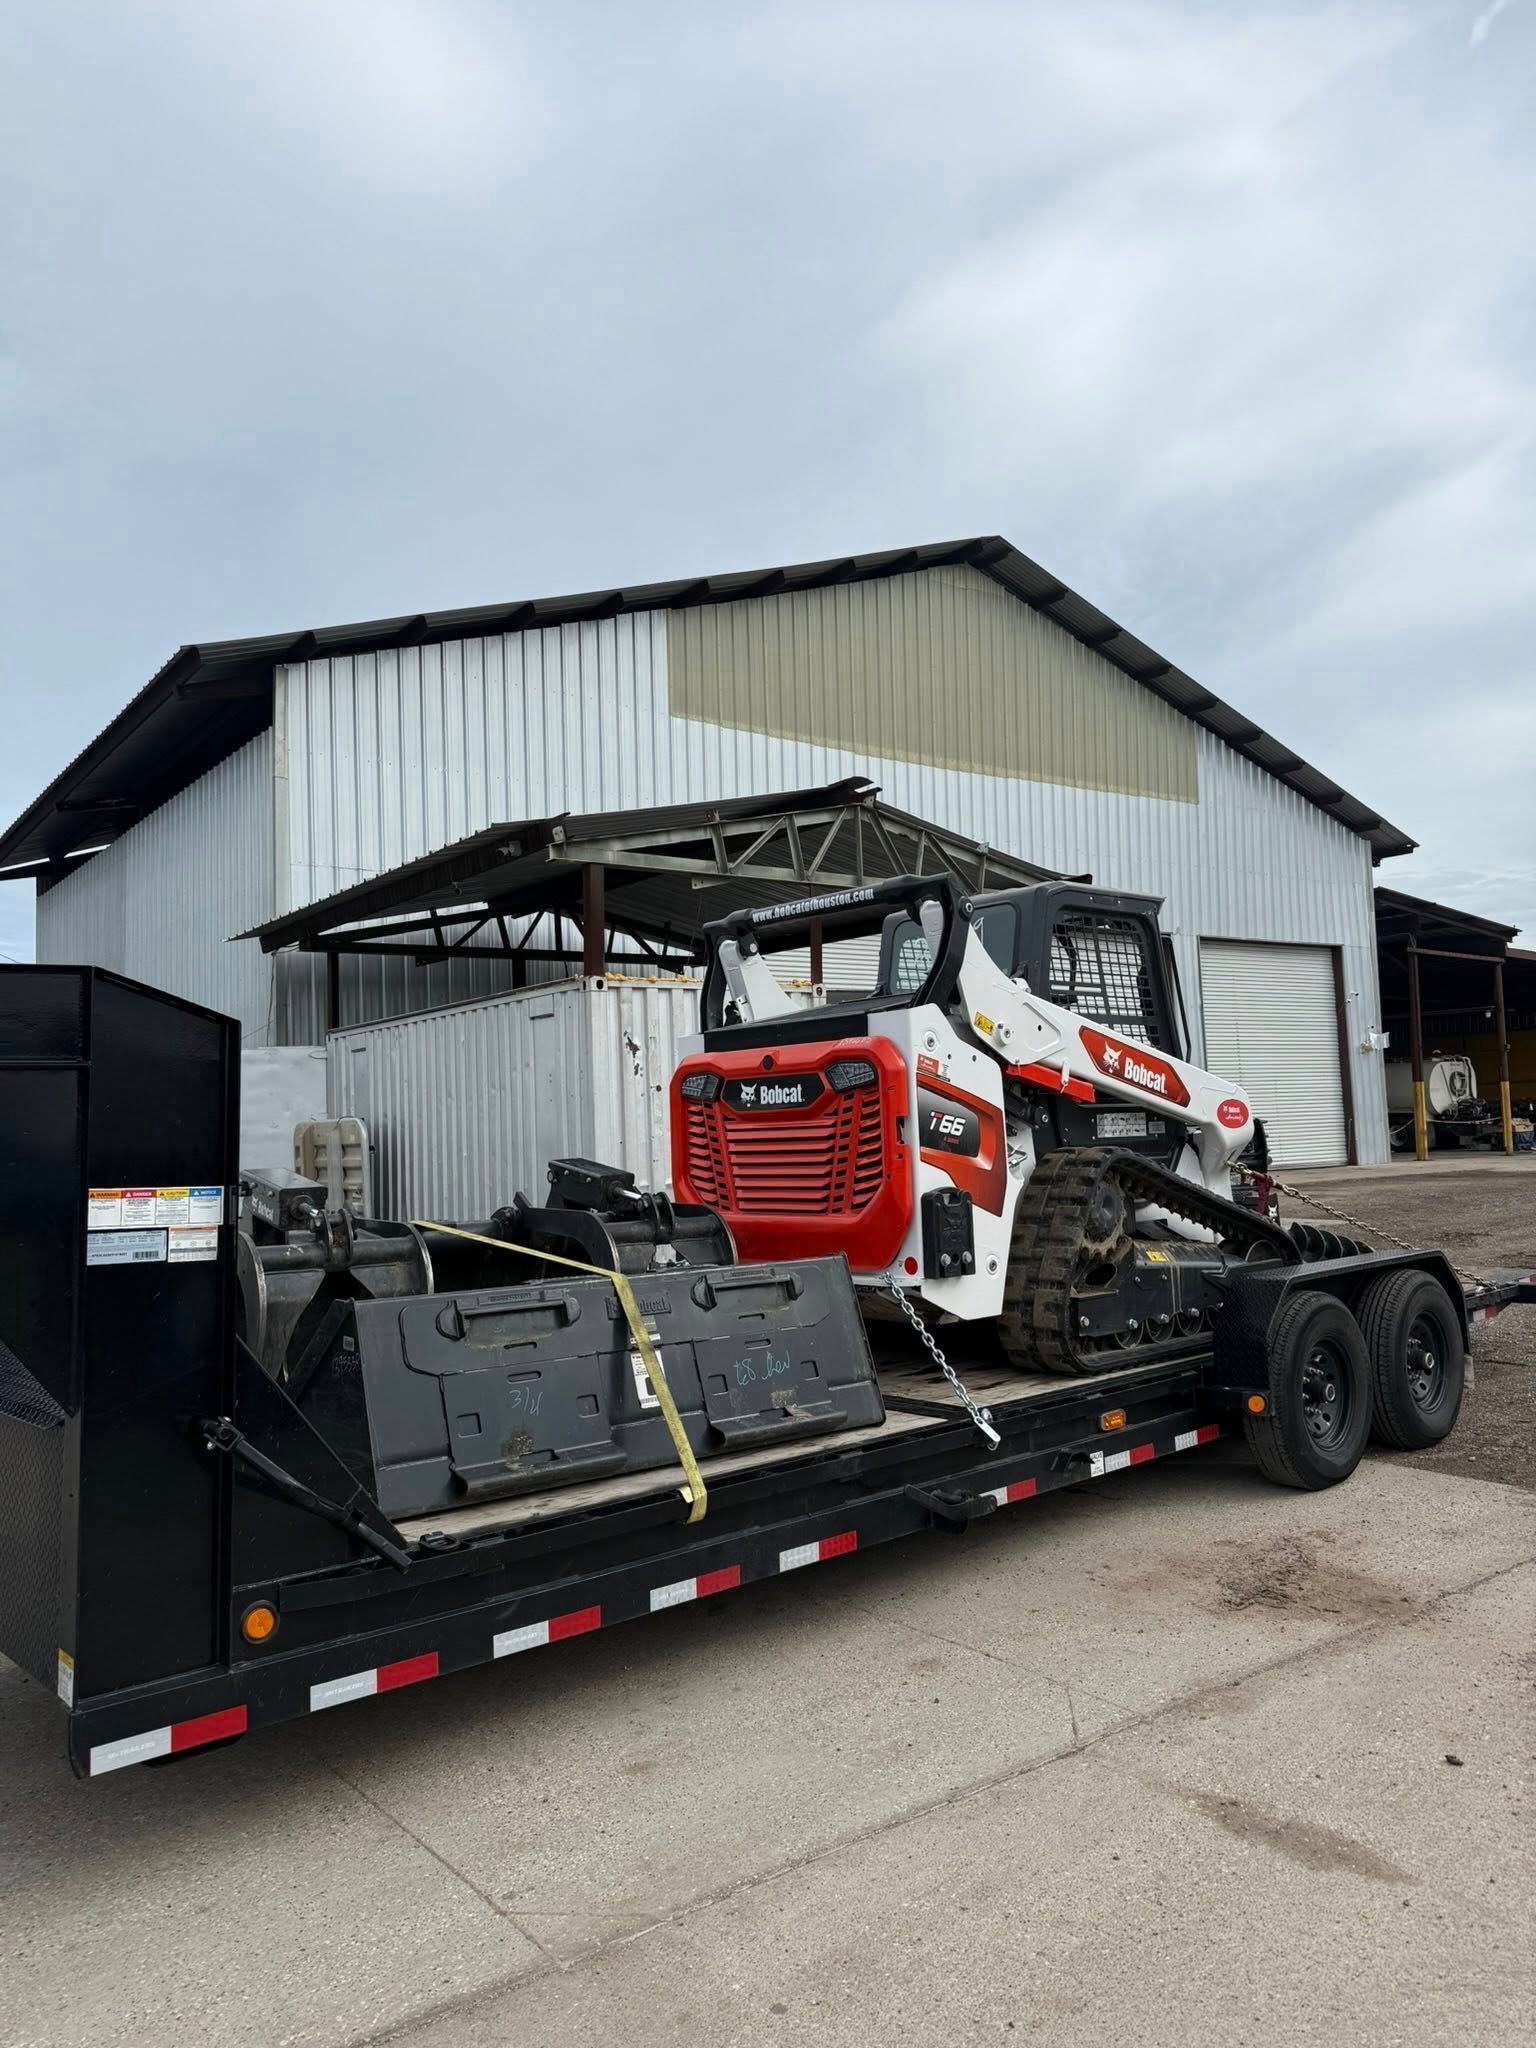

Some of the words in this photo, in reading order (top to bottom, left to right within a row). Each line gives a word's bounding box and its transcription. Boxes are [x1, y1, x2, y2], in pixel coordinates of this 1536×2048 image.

[752, 888, 874, 923] www.bobcatofhouston.com
[1124, 1056, 1167, 1094] Bobcat
[760, 1083, 803, 1105] Bobcat
[930, 1111, 966, 1136] T66
